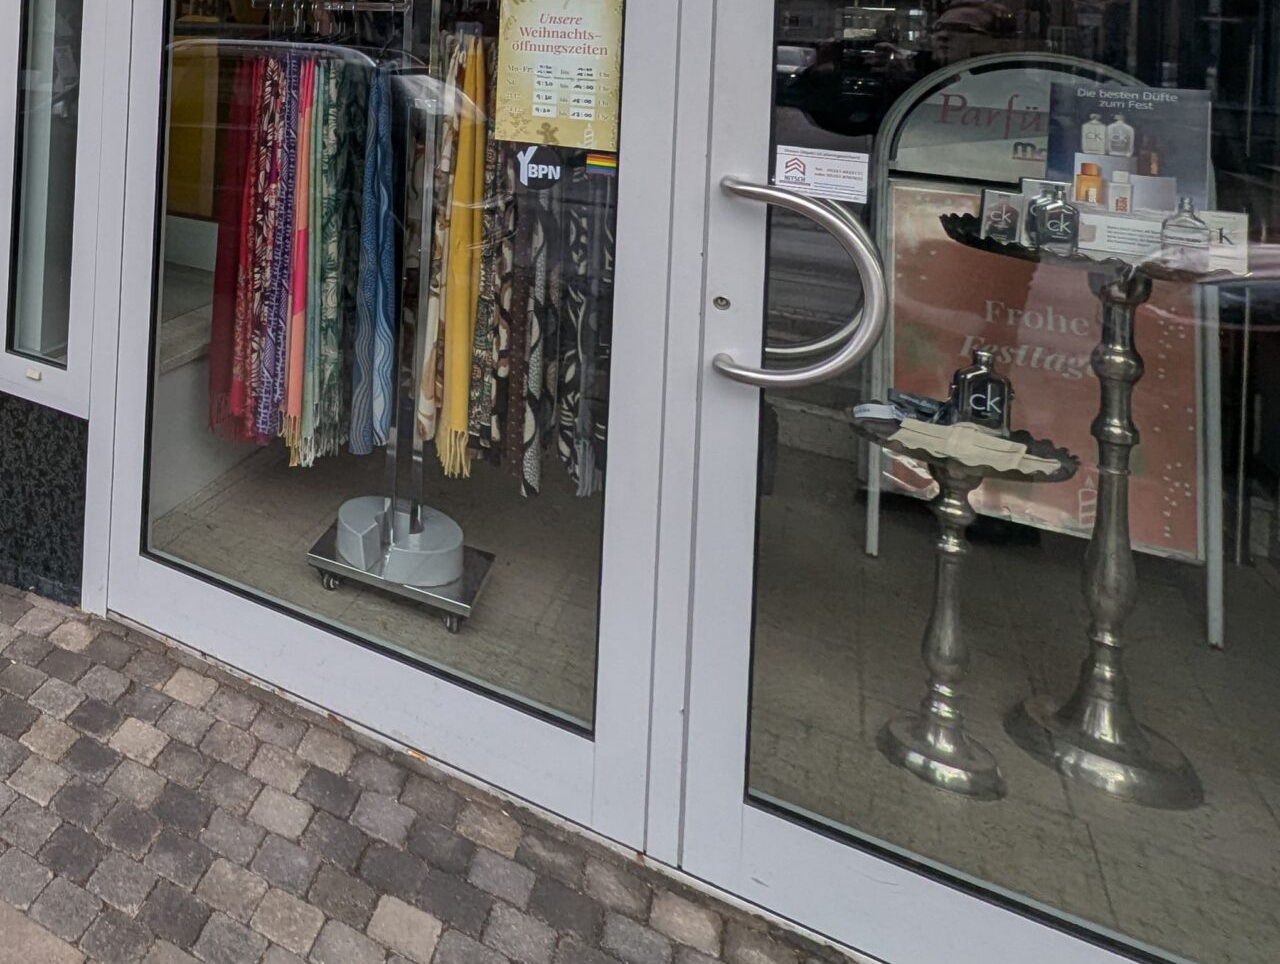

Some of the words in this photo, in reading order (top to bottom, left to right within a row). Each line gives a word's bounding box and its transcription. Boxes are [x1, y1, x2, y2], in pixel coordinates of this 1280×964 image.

[539, 13, 583, 25] Unsere
[519, 26, 602, 40] Weihnachts-
[511, 40, 609, 56] öffnungszeiten
[1077, 88, 1096, 98] Die
[1099, 89, 1139, 100] besten
[1142, 91, 1179, 102] Düfte
[1099, 100, 1125, 109] zum
[1128, 101, 1154, 110] Fest
[937, 93, 1042, 140] Parfü
[1047, 213, 1072, 234] ck
[984, 299, 1090, 337] Frohe
[969, 383, 1003, 414] ck
